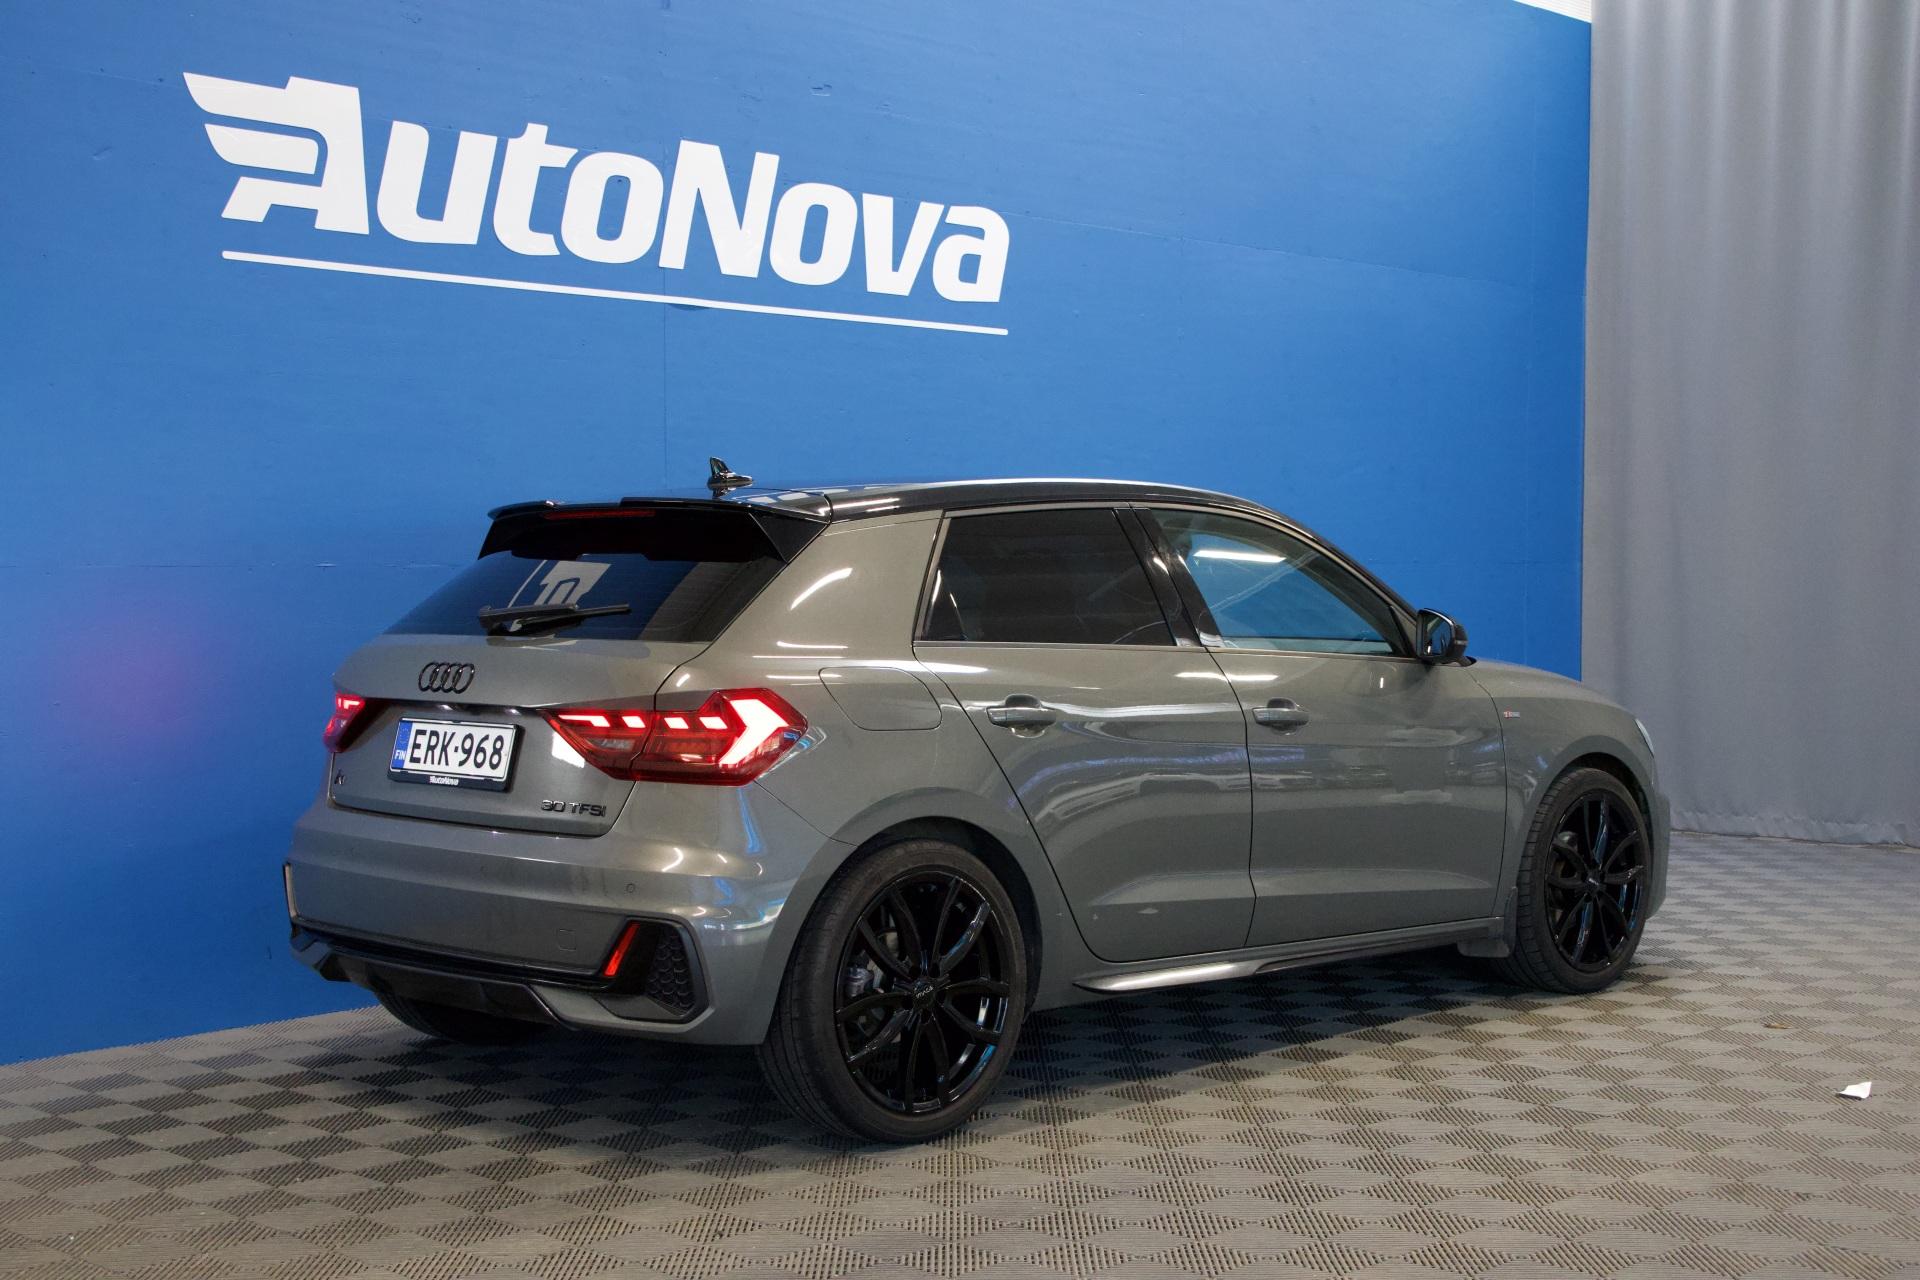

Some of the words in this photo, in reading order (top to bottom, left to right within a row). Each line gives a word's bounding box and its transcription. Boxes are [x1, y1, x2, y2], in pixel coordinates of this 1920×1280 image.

[183, 72, 1010, 302] AutoNova
[394, 749, 407, 761] FIN
[409, 729, 505, 771] ERK-968
[541, 800, 565, 812] 30
[569, 802, 606, 817] TFSI
